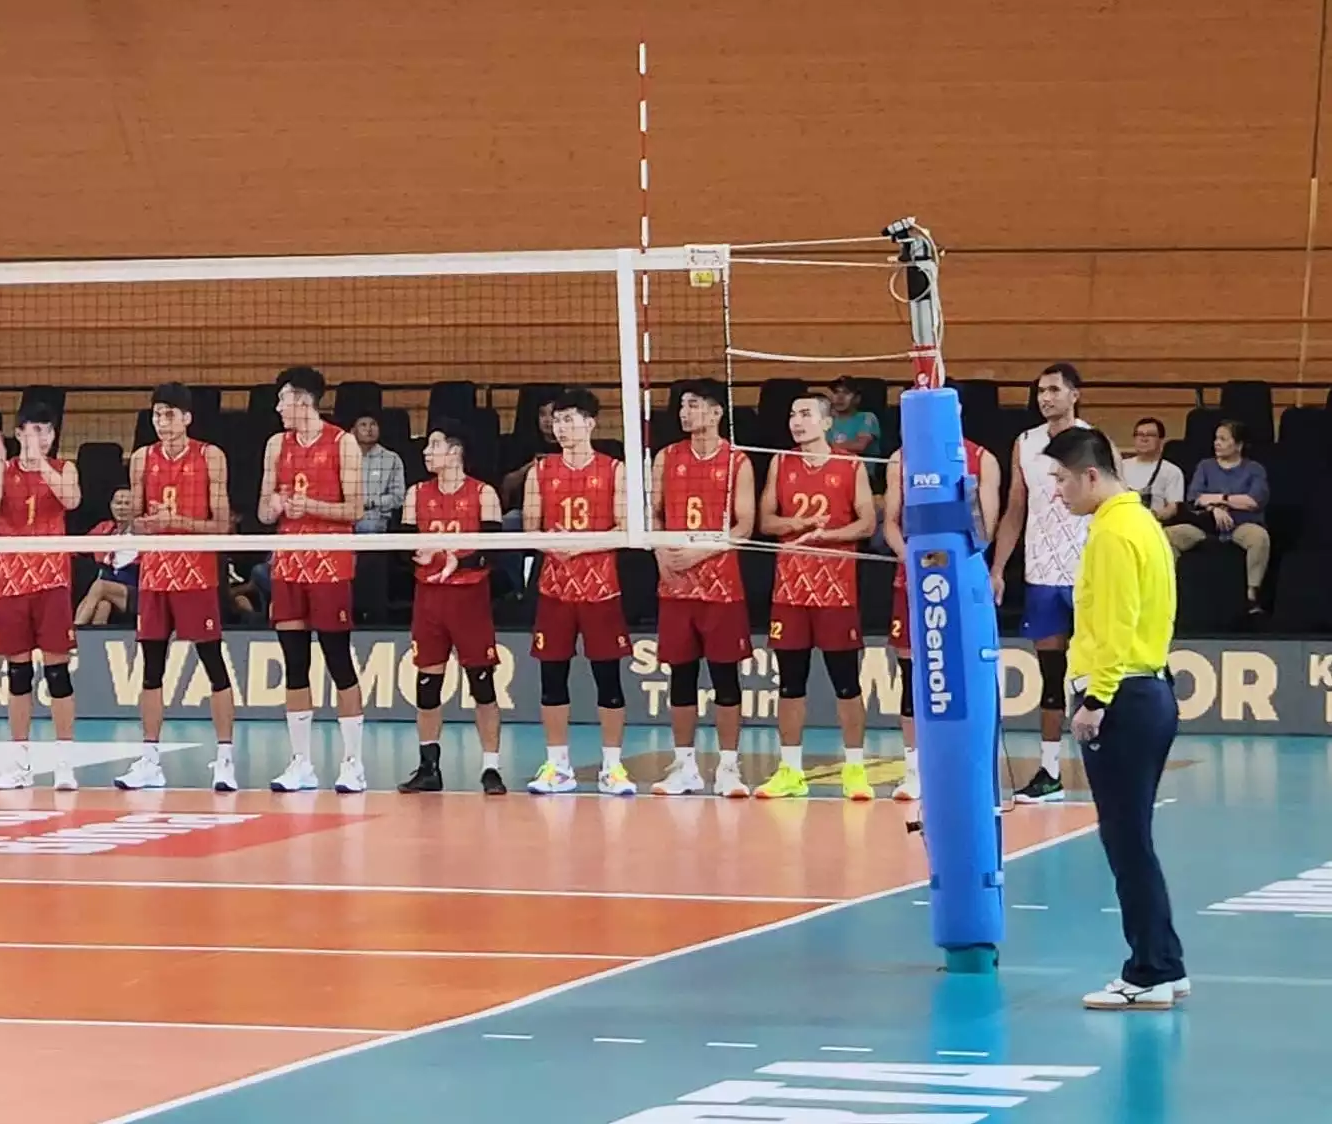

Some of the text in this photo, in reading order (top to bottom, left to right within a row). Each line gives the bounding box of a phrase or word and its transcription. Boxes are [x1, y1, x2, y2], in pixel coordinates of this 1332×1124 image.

[25, 495, 36, 525] 1
[560, 497, 589, 530] 13
[686, 496, 703, 530] 6
[925, 605, 952, 714] Senoh
